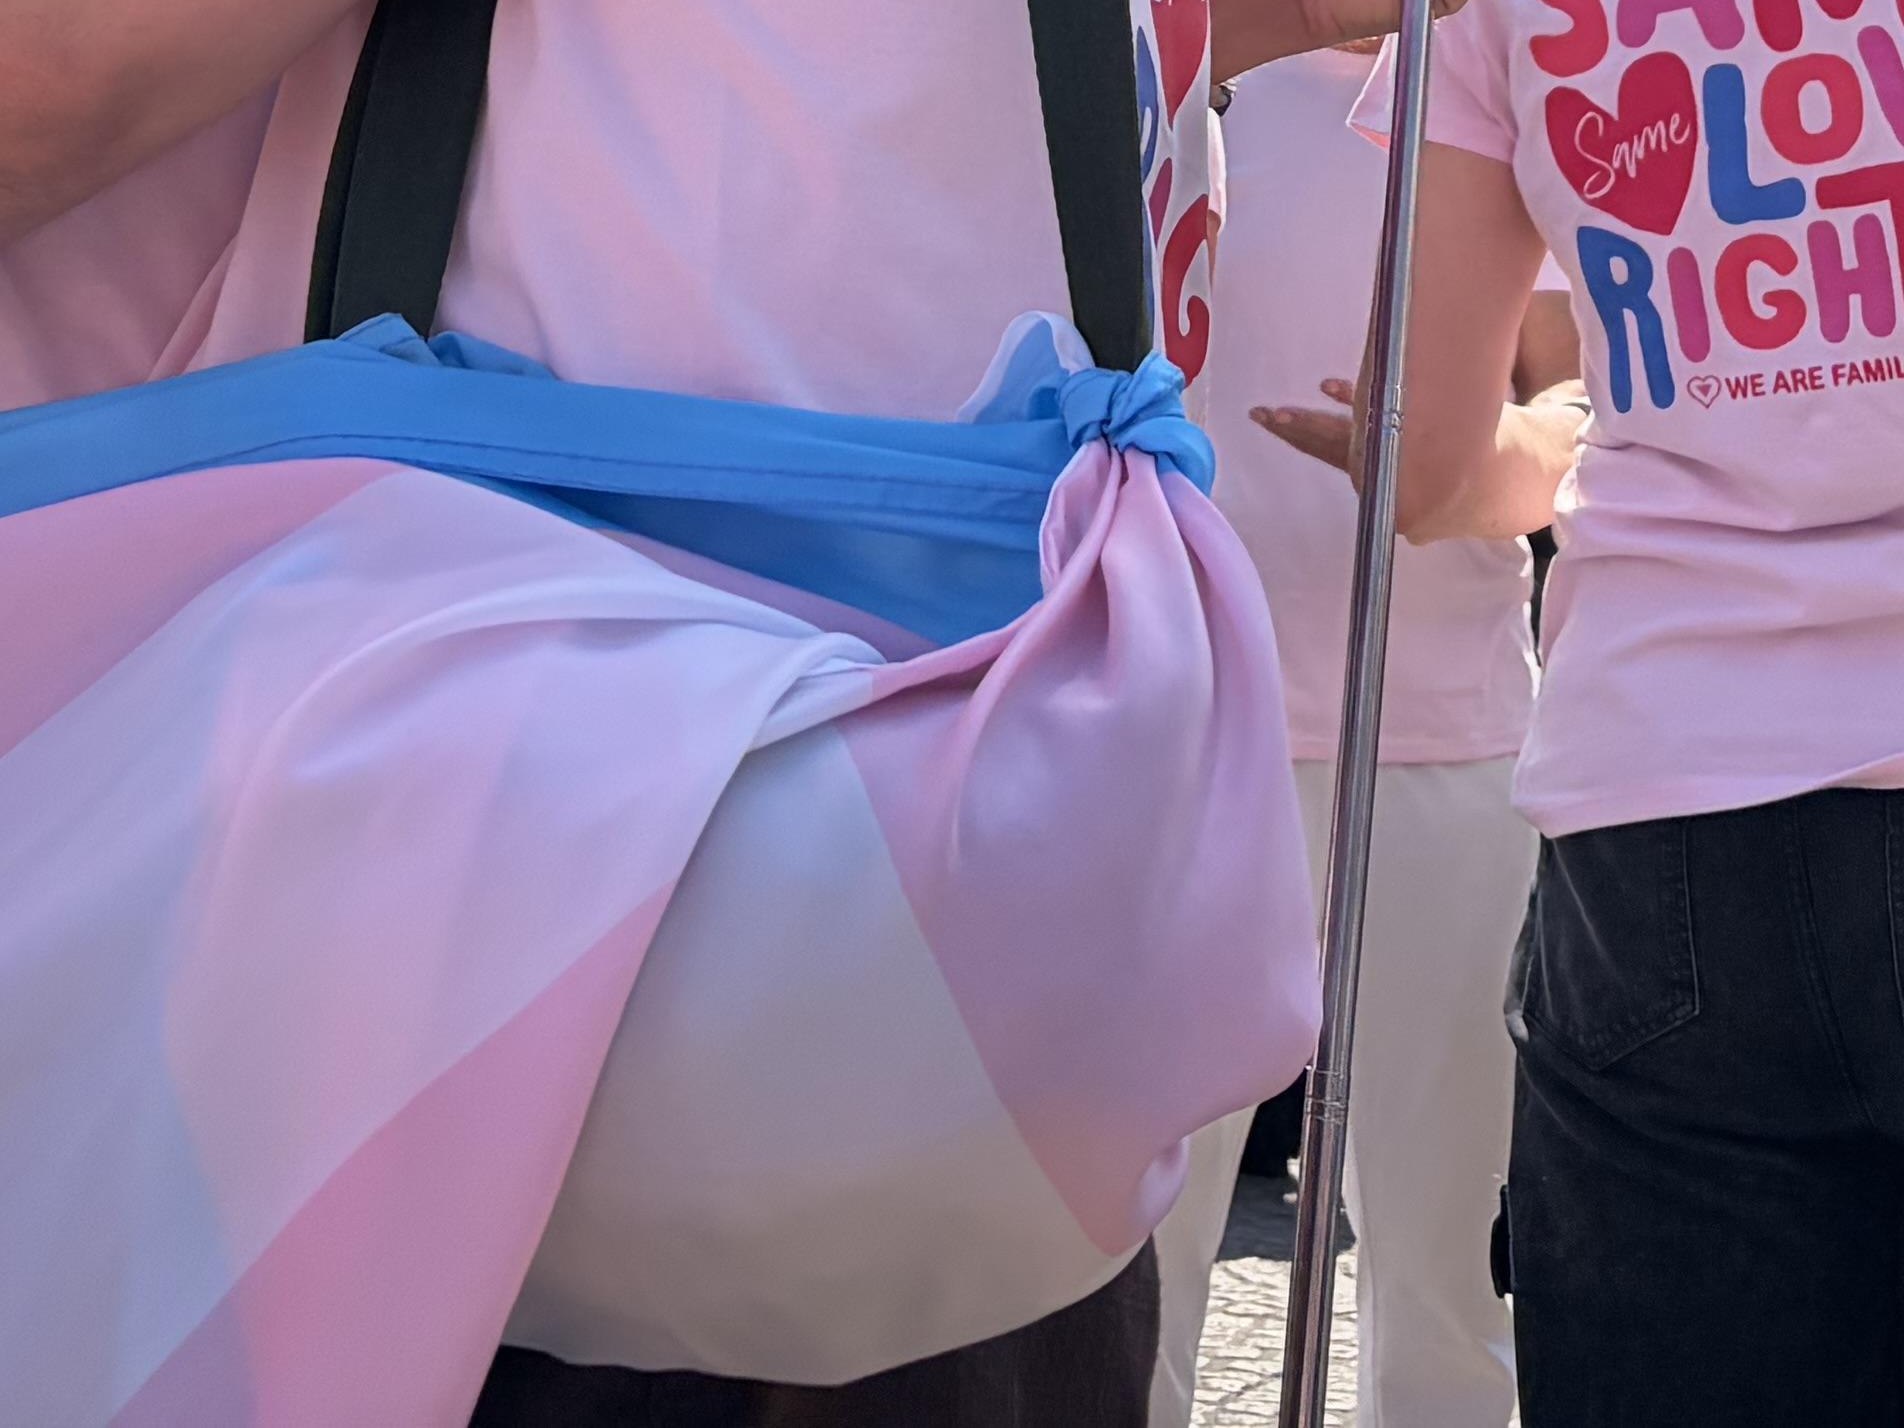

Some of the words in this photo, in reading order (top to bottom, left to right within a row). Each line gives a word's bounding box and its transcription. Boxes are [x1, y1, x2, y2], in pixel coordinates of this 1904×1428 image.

[1574, 111, 1690, 199] Same
[1725, 373, 1766, 400] WE
[1772, 365, 1825, 394] ARE
